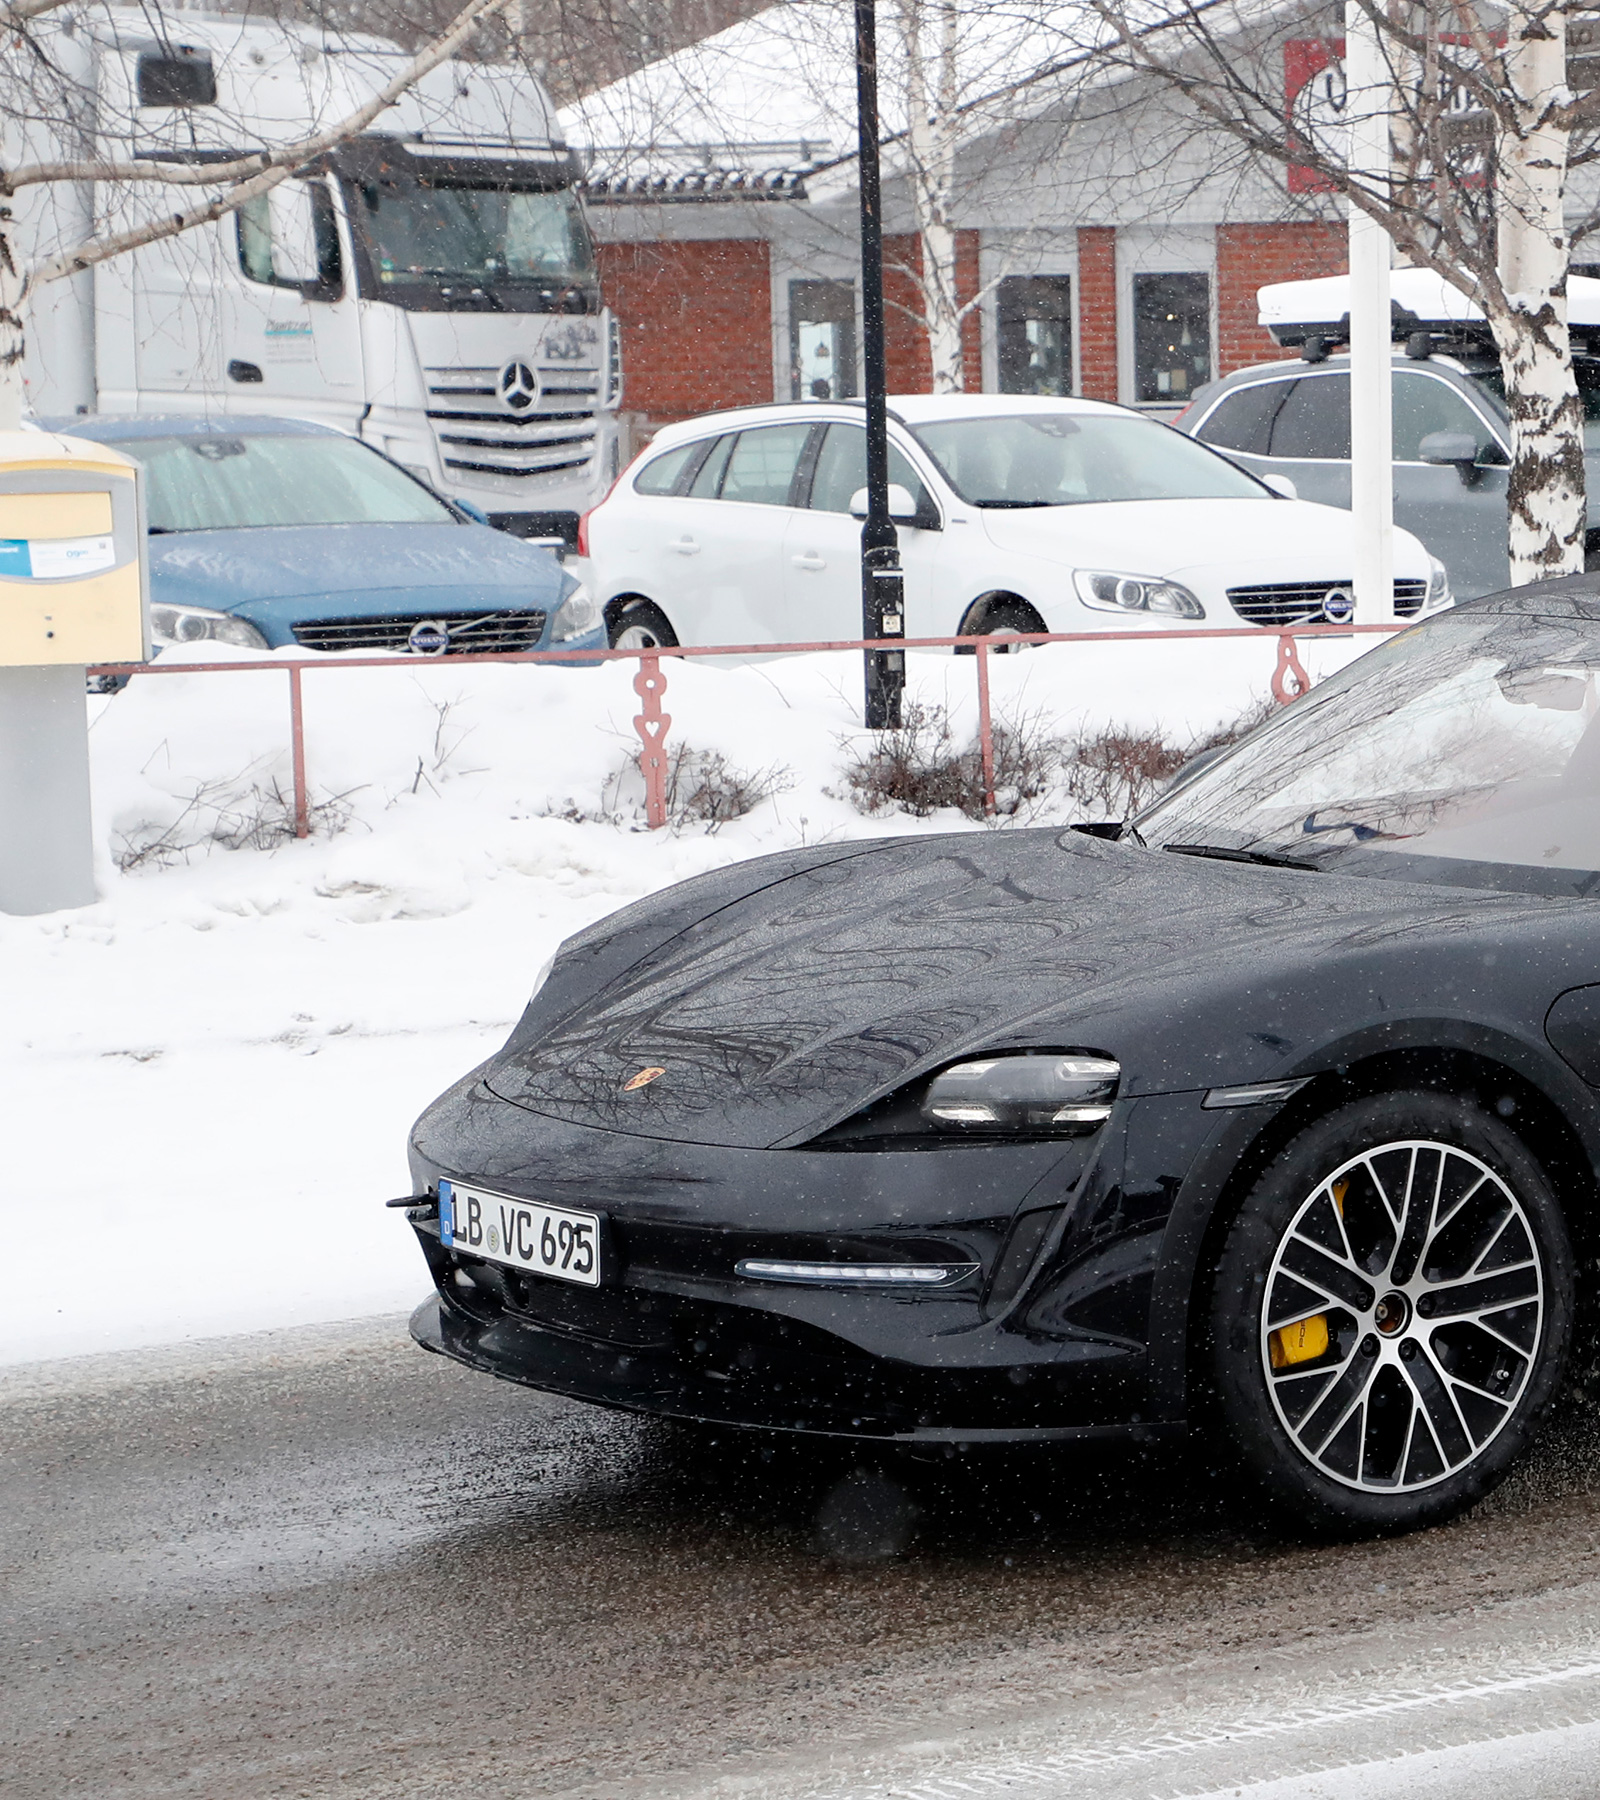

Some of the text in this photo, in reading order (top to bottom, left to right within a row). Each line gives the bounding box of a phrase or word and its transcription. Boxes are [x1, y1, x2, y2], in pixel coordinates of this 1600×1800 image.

[453, 1191, 593, 1275] LB VC 695
